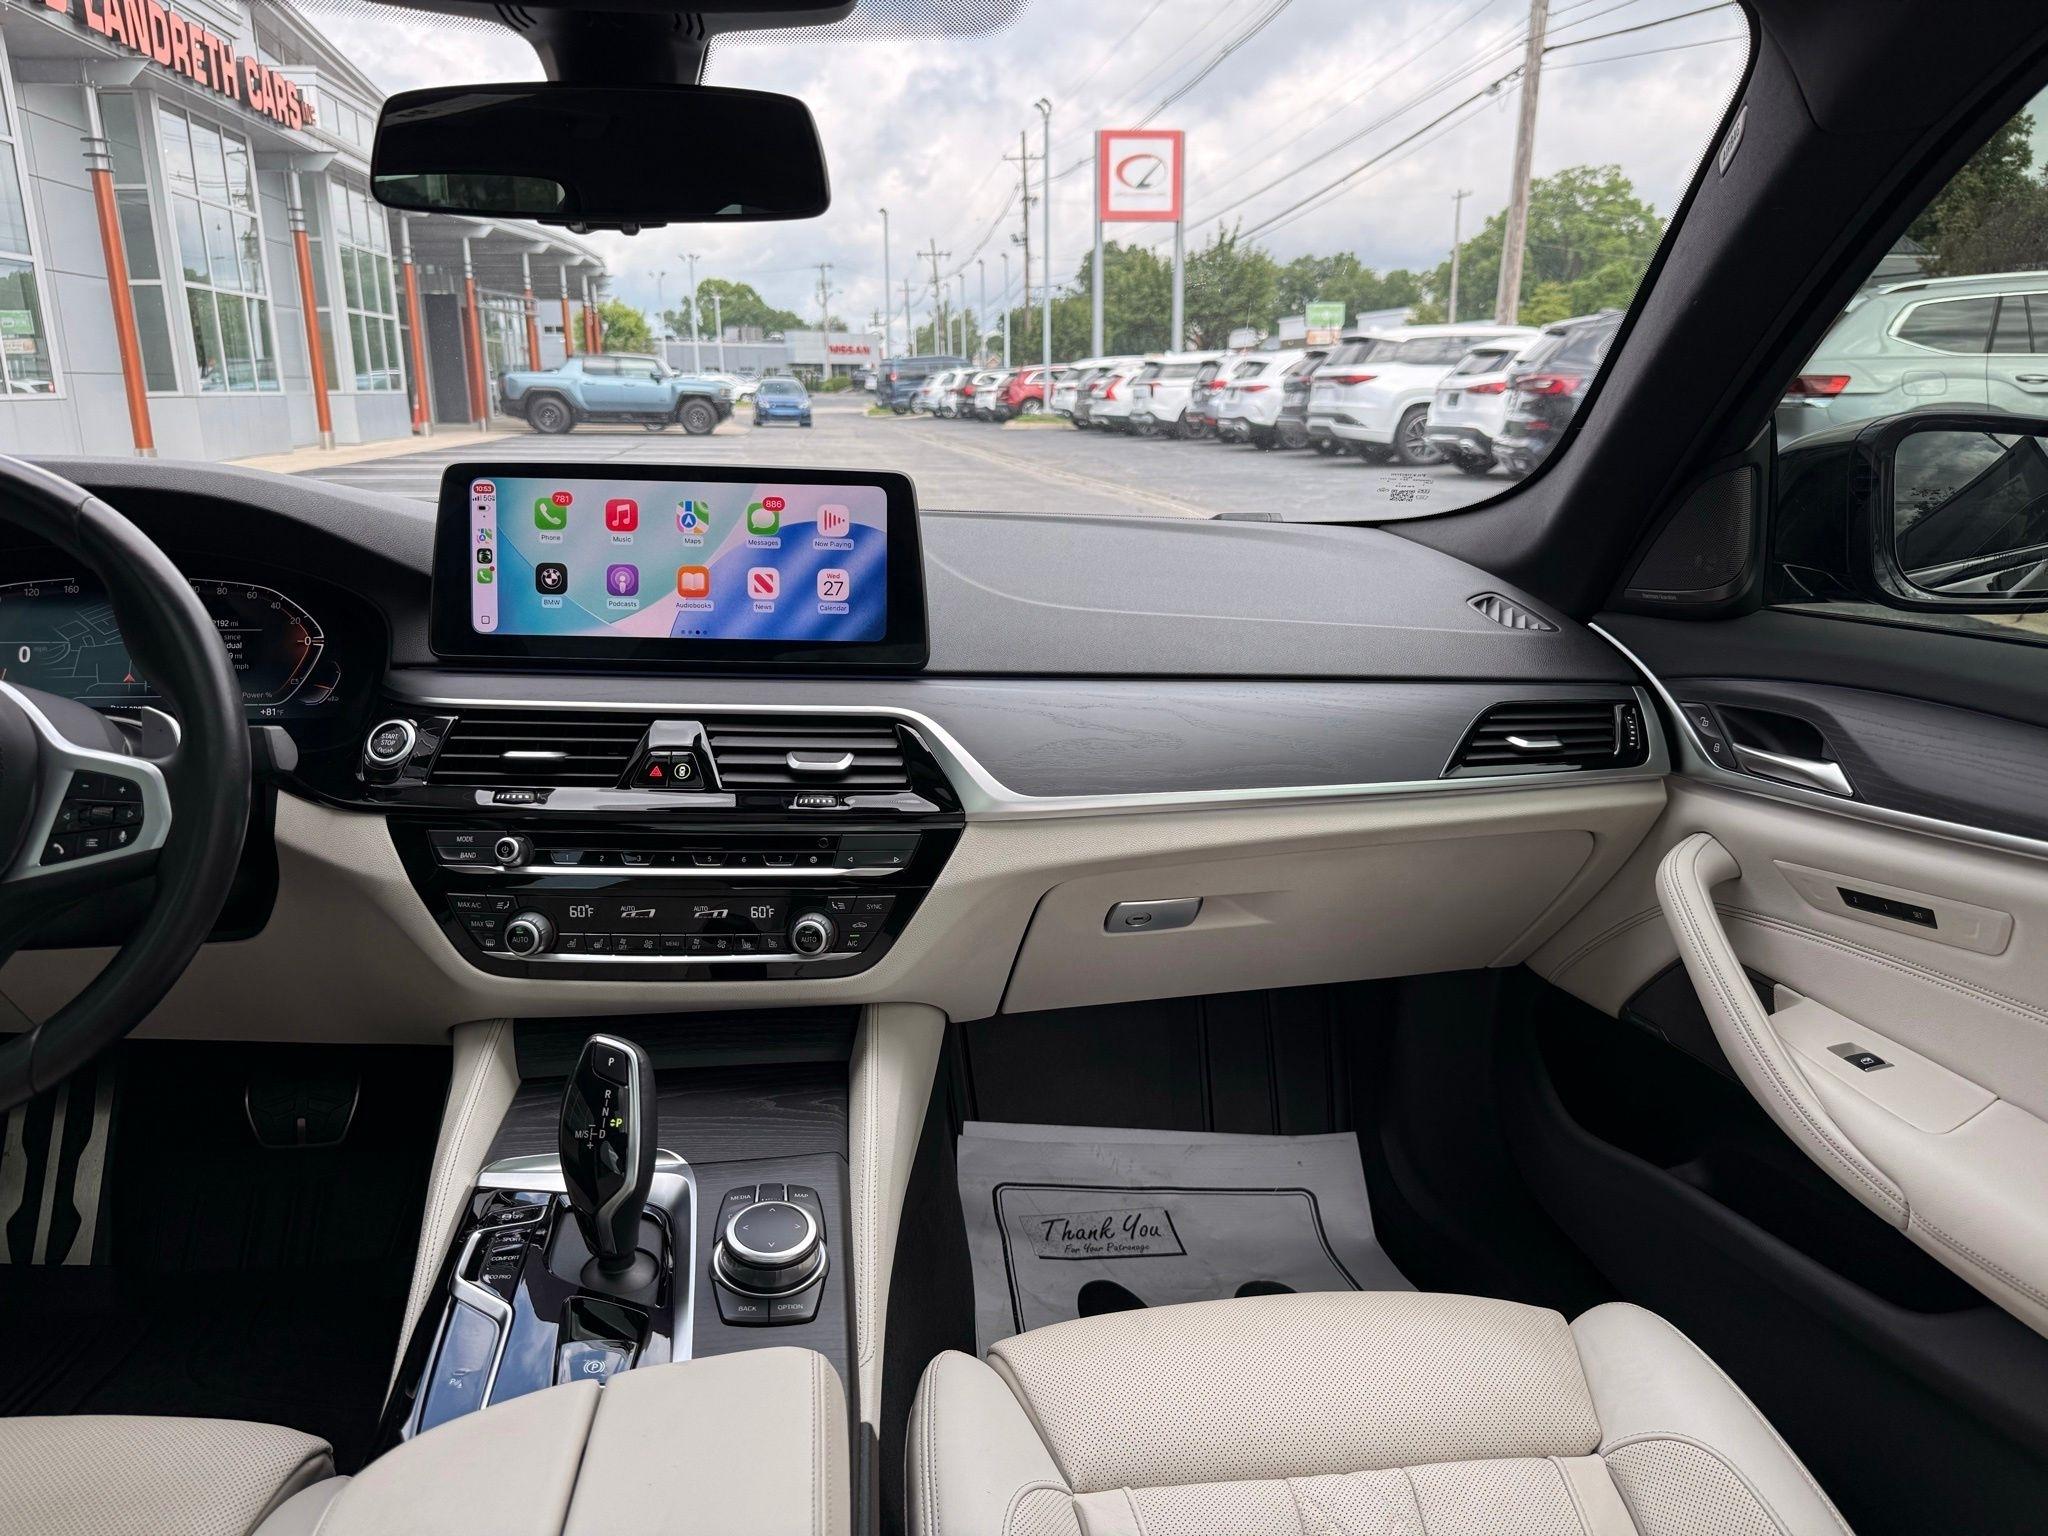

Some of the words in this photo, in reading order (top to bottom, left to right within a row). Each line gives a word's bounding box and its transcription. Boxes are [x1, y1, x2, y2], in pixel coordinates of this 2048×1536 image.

[84, 0, 240, 100] LANDRETH
[243, 55, 303, 131] CARS
[555, 494, 569, 503] 781
[541, 534, 561, 542] Phone
[748, 539, 778, 547] Messages
[830, 541, 852, 549] Playing
[24, 588, 40, 597] 120
[64, 585, 80, 594] 160
[216, 587, 228, 595] 80
[823, 581, 844, 596] 27
[246, 591, 258, 599] 60
[270, 601, 281, 609] 40
[755, 603, 772, 611] News
[290, 617, 301, 625] 20
[18, 646, 31, 663] 0
[260, 708, 276, 716] +81
[608, 1057, 615, 1066] P
[604, 1089, 612, 1099] R
[601, 1106, 609, 1117] N
[574, 1130, 589, 1139] M/S
[599, 1129, 606, 1139] D
[1041, 1216, 1116, 1242] Thank
[1122, 1213, 1162, 1240] You
[1064, 1243, 1080, 1253] For
[1083, 1243, 1104, 1253] Your
[1106, 1242, 1151, 1253] Patronage
